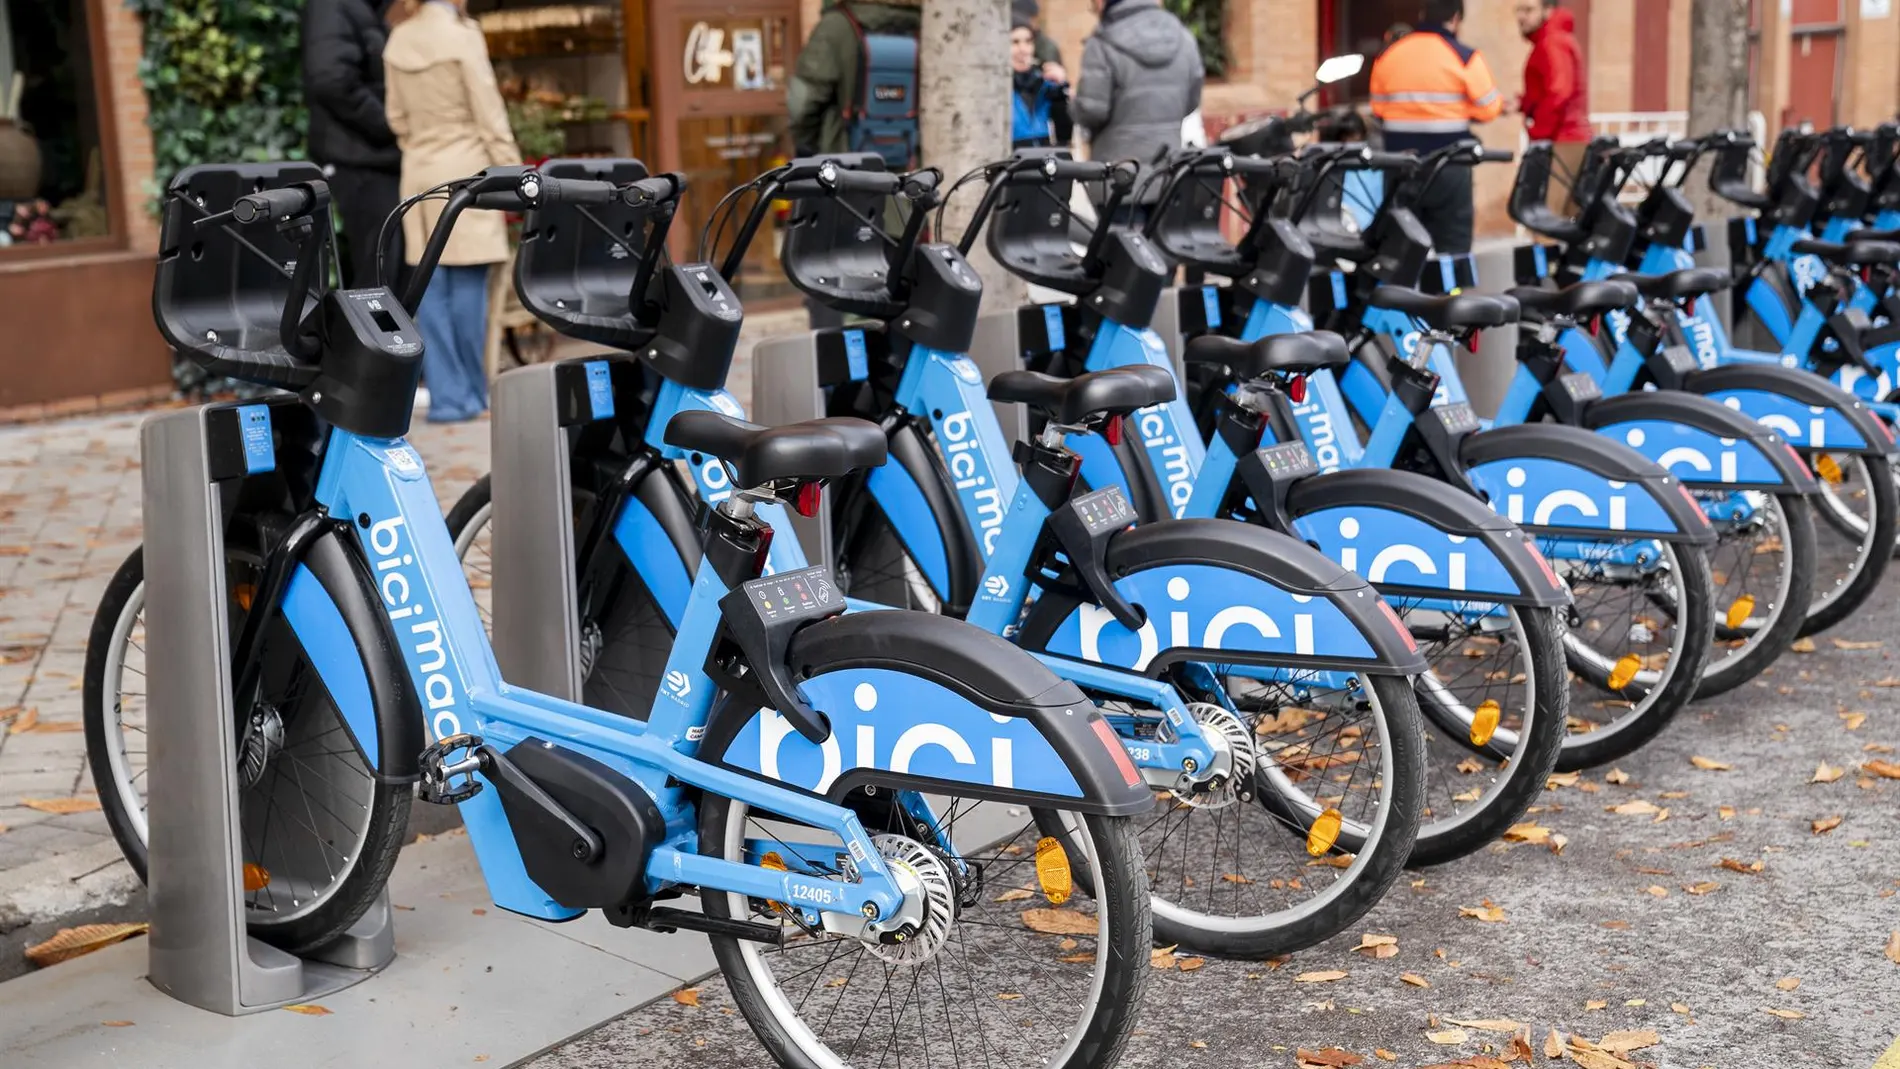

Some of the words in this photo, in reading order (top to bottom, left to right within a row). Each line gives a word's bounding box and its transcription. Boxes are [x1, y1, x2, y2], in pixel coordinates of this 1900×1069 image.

[1138, 402, 1174, 447] ici
[1488, 467, 1626, 530] ici
[1339, 517, 1466, 591] ici
[1079, 576, 1315, 672] bici
[759, 682, 1014, 796] bici
[792, 883, 832, 904] 12405
